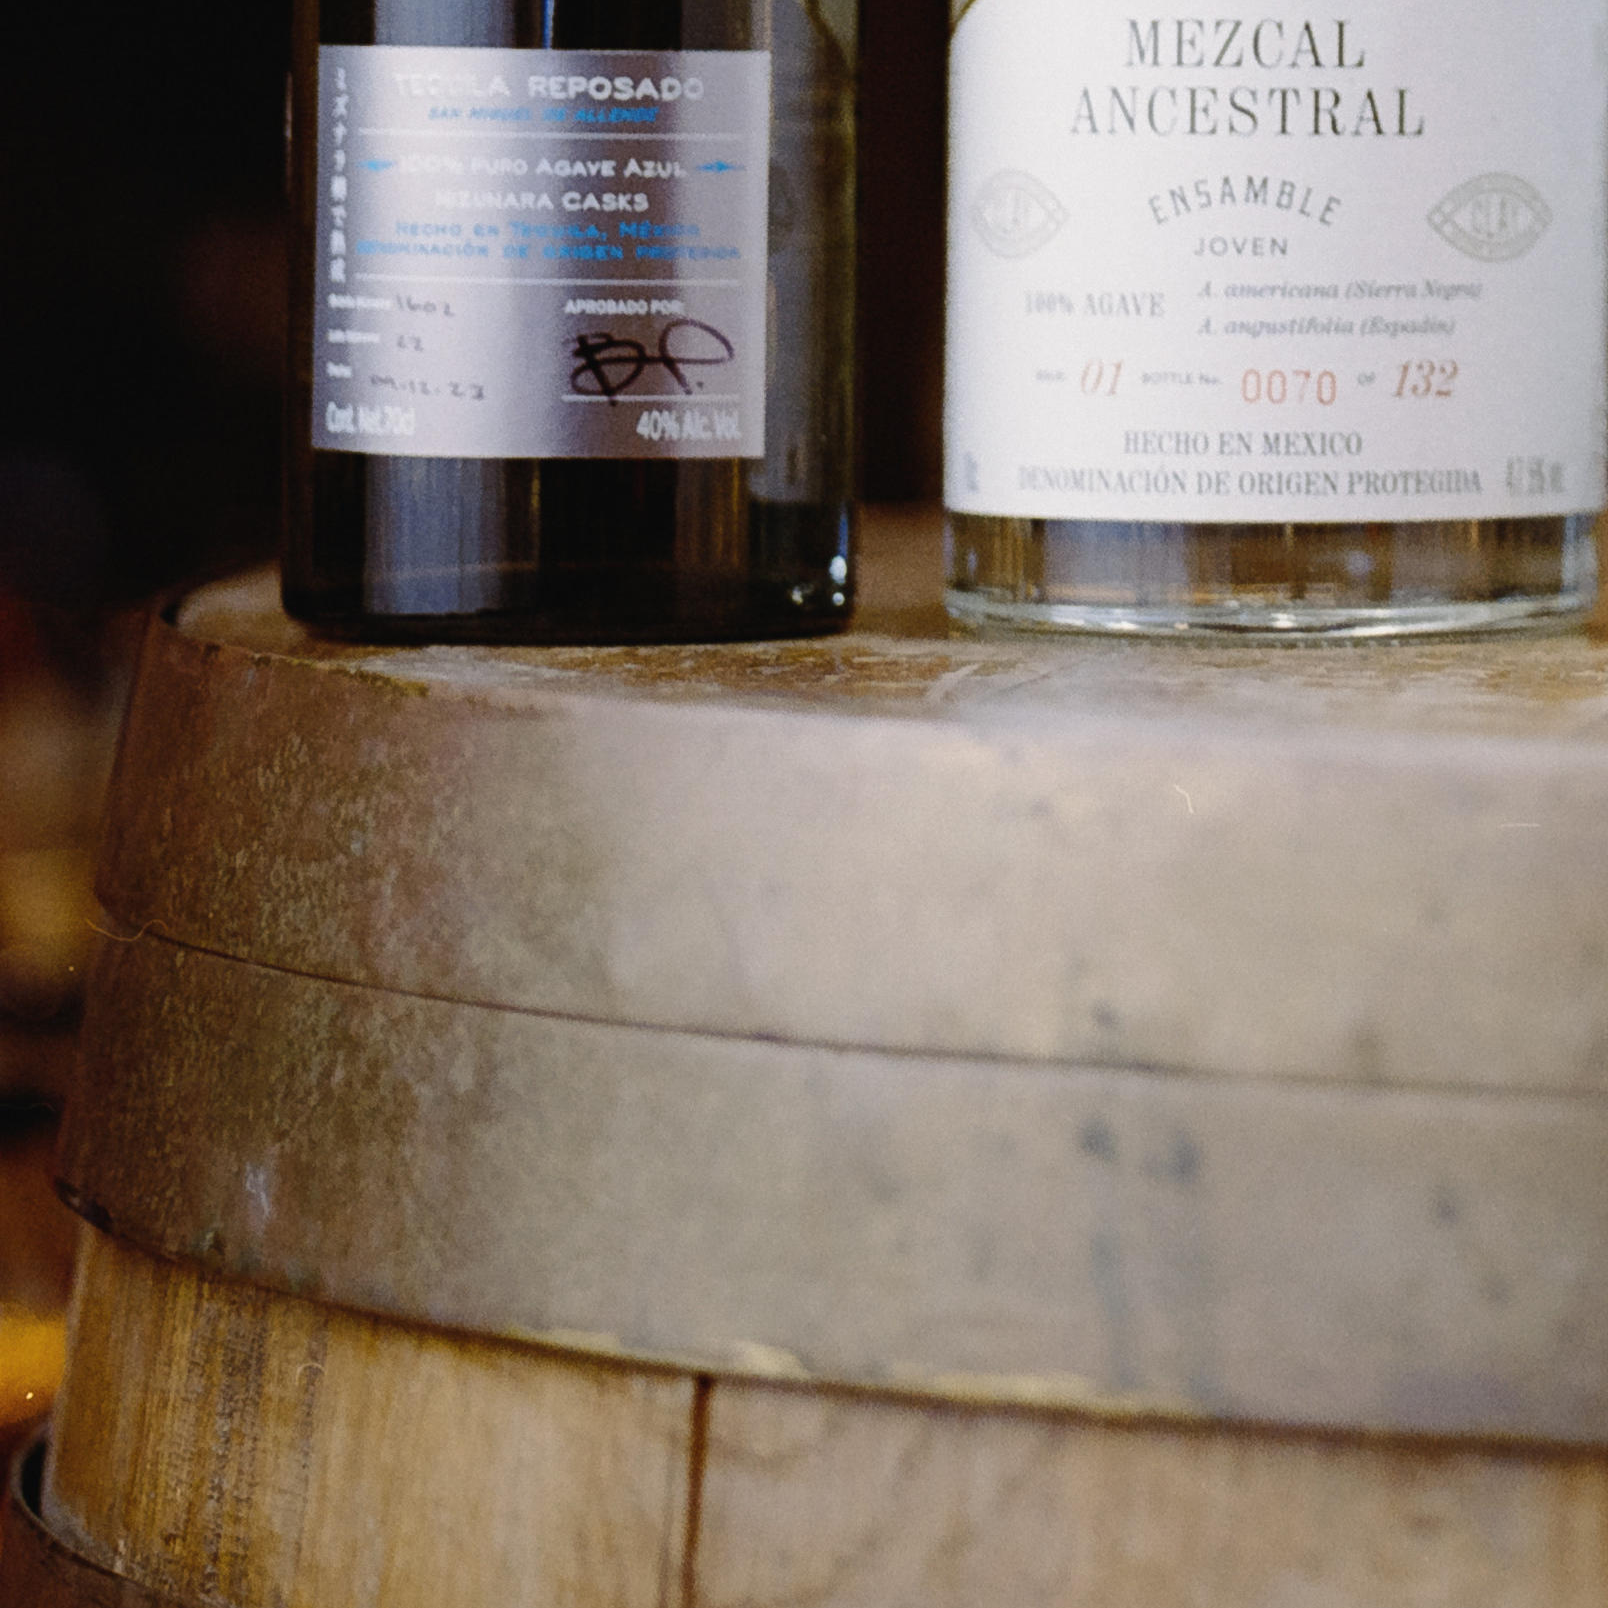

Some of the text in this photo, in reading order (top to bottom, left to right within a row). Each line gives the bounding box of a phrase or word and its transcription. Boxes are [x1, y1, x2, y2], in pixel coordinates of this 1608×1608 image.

[1124, 18, 1365, 69] MEZCAL
[527, 75, 704, 101] REPOSADO
[1070, 86, 1425, 138] ANCESTRAL
[536, 158, 618, 178] AGAVE
[624, 157, 688, 178] AZUL
[562, 191, 650, 213] CASKS
[1148, 175, 1342, 227] ENSAMBLE
[1194, 236, 1289, 257] JOVEN
[1223, 281, 1340, 300] americana
[564, 298, 649, 316] APROBADO
[1085, 291, 1166, 318] AGAVE
[1080, 359, 1124, 397] 01
[1241, 368, 1338, 407] 0070
[1394, 358, 1460, 399] 132
[635, 409, 681, 442] 40%
[1123, 430, 1364, 457] HECHO EN MEXICO
[1017, 465, 1188, 496] DENOMINACIÓN
[1196, 469, 1232, 496] DE
[1237, 469, 1340, 497] ORIGEN
[1346, 469, 1484, 497] PROTEGIDA
